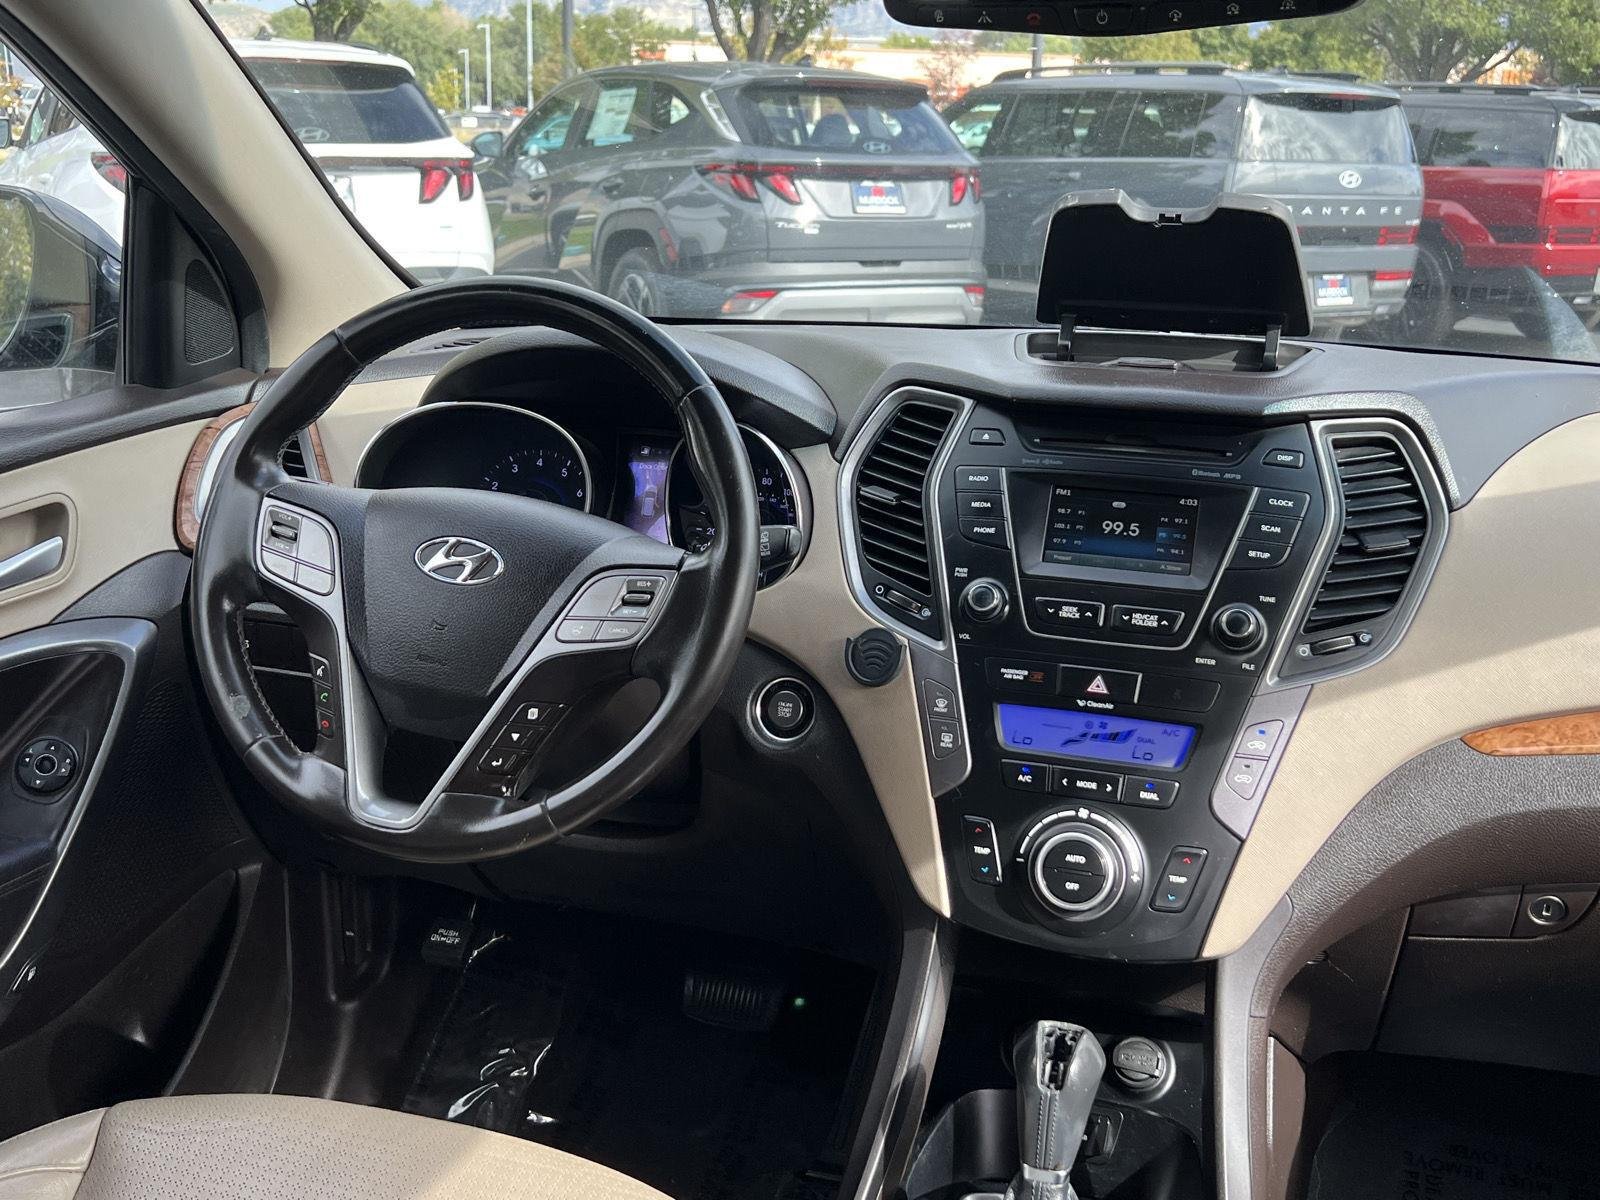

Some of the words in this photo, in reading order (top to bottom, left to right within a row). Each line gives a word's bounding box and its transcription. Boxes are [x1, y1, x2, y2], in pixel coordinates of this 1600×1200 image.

[536, 458, 543, 467] 4
[1277, 454, 1294, 462] DISP
[511, 464, 519, 473] 3
[561, 468, 568, 477] 5
[491, 481, 499, 490] 2
[761, 477, 773, 486] 80
[576, 489, 583, 497] 6
[1055, 488, 1072, 496] FM1
[1179, 498, 1198, 506] 4:03
[1268, 499, 1294, 507] CLOCK
[973, 526, 996, 534] PHONE
[1102, 520, 1140, 537] 99.5
[1261, 525, 1281, 533] SCAN
[1248, 550, 1271, 559] SETUP
[1258, 595, 1277, 603] TUNE
[1061, 605, 1079, 613] SEEK
[1058, 610, 1081, 619] TRACK
[1132, 612, 1159, 621] HD/CAT
[1131, 618, 1159, 627] FOLDER
[1195, 657, 1216, 666] ENTER
[1242, 662, 1256, 671] FILE
[1086, 700, 1115, 710] CleanAir
[1161, 728, 1181, 737] A/C
[1136, 736, 1158, 745] DUAL
[1017, 774, 1033, 783] A/C
[1075, 780, 1098, 790] MODE
[1139, 790, 1160, 801] DUAL
[973, 845, 991, 855] TEMP
[1065, 853, 1087, 864] AUTO
[1168, 874, 1188, 884] TEMP
[1064, 881, 1080, 892] OFF
[438, 928, 459, 937] PUSH
[446, 936, 460, 944] OFF
